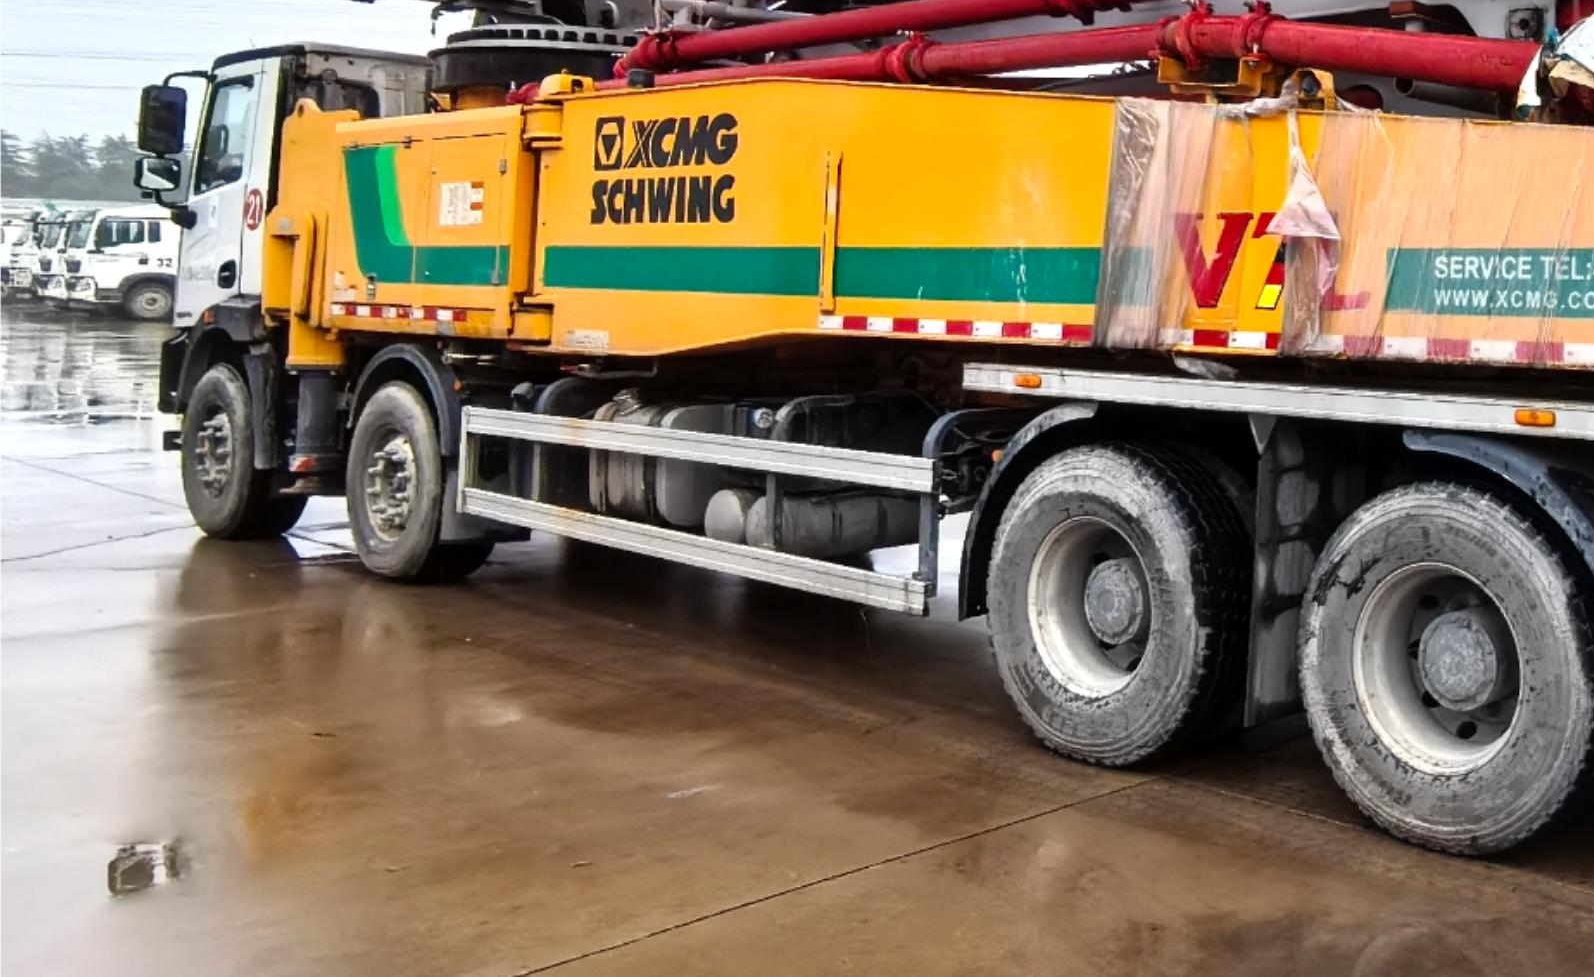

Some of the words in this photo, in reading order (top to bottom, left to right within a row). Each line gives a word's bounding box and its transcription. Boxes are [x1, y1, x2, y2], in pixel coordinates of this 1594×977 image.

[623, 112, 738, 169] XCMG
[246, 194, 261, 224] 21
[590, 174, 735, 224] SCHWING
[1434, 255, 1532, 281] SERVICE
